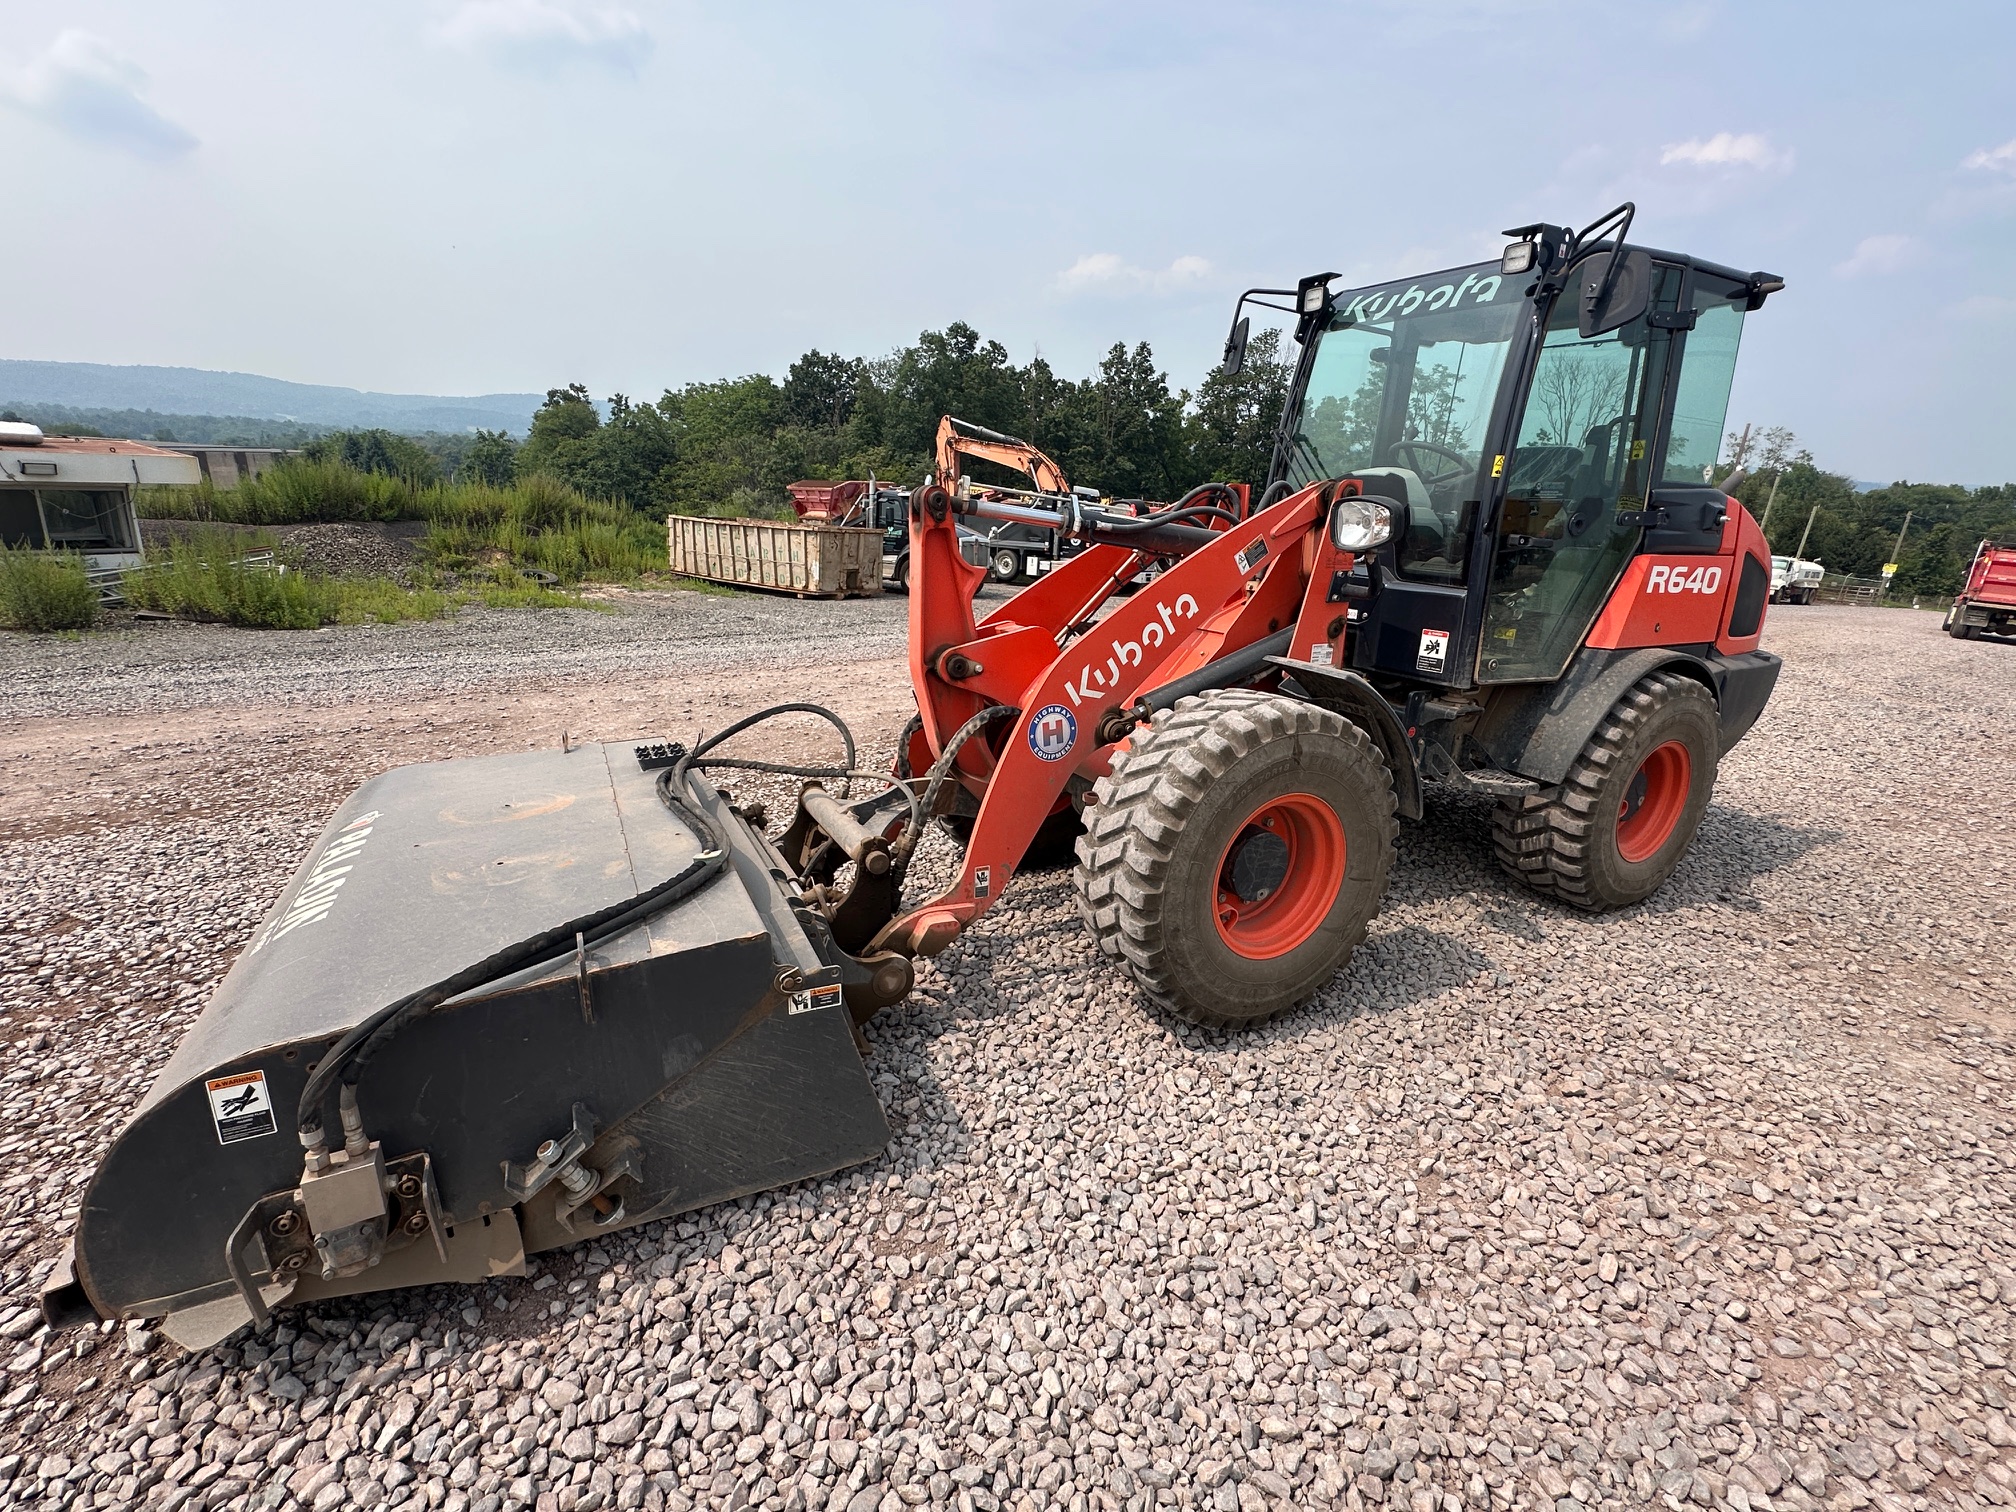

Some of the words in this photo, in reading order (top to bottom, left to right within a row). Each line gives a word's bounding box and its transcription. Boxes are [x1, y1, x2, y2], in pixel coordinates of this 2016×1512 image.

[1343, 272, 1502, 323] Kubota
[735, 545, 799, 562] EARTH
[1646, 565, 1722, 595] R640
[1064, 593, 1200, 707] Kubota
[1033, 706, 1071, 724] HIGHWAY
[1042, 719, 1064, 747] H
[1033, 740, 1073, 760] EQUIPMENT
[221, 1074, 258, 1087] WARNING
